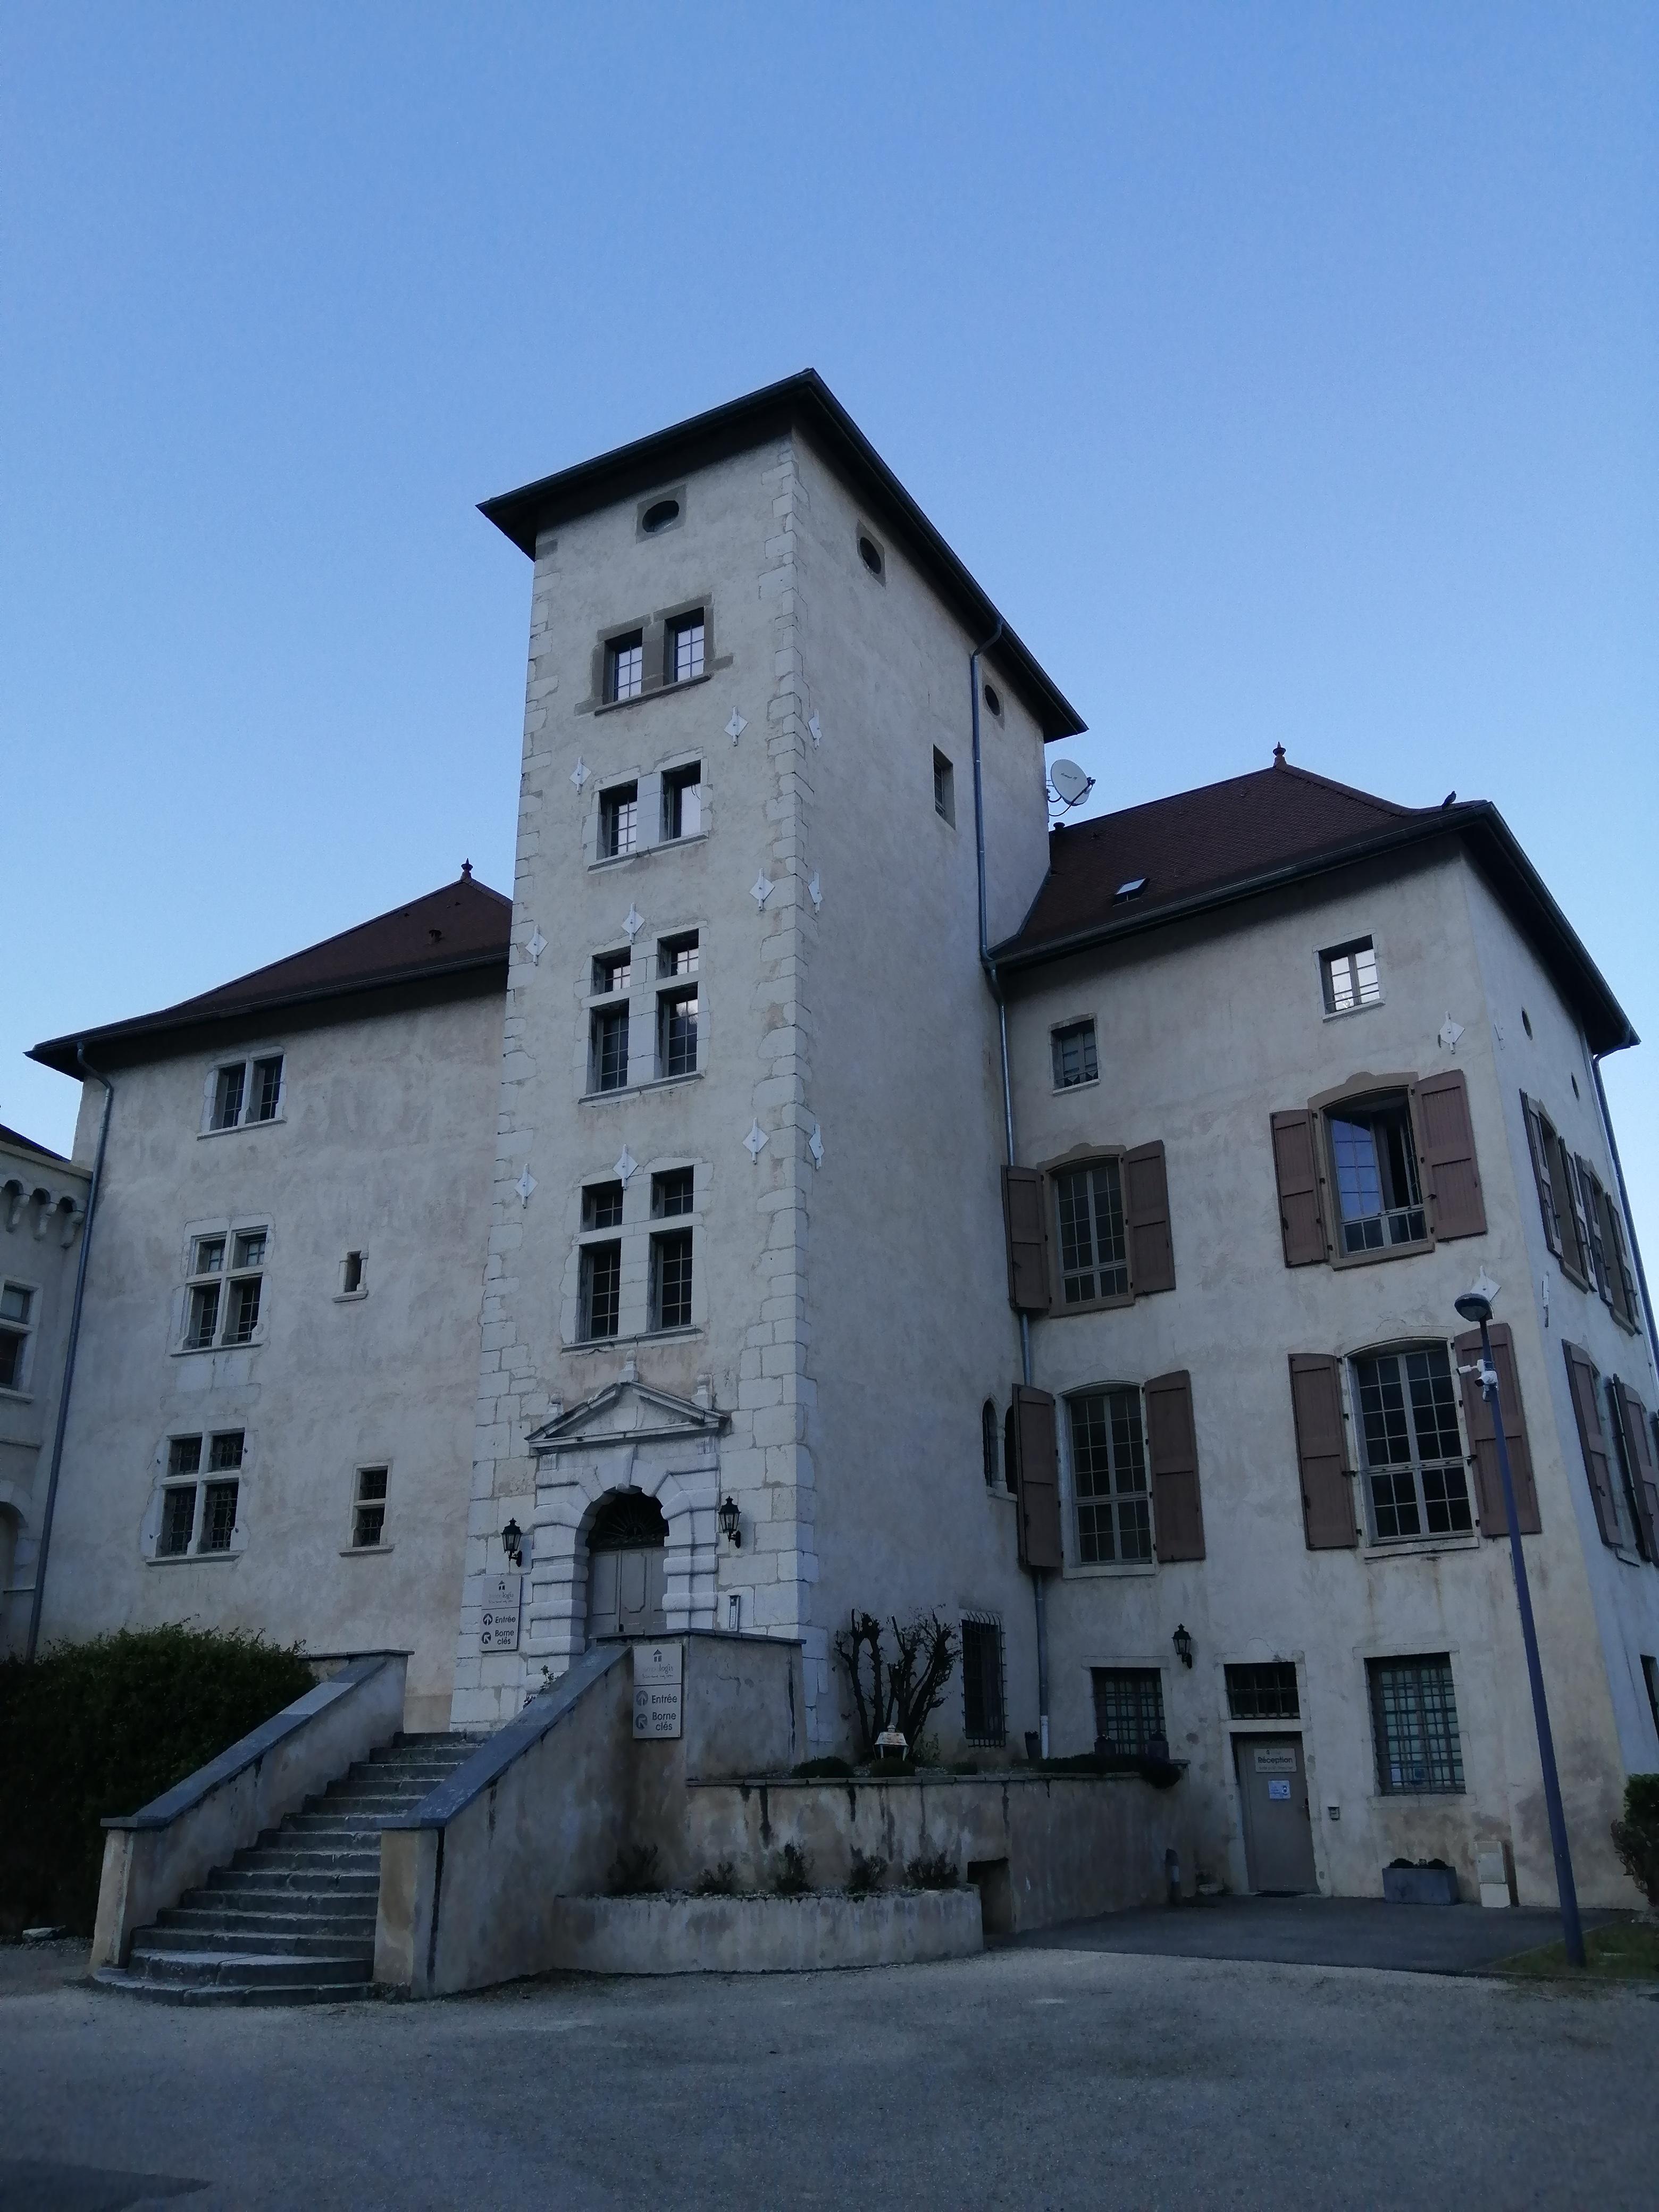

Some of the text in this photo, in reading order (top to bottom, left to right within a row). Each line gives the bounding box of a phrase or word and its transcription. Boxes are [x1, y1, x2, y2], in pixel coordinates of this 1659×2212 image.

[495, 1615, 516, 1623] Entrée
[497, 1637, 511, 1645] clés
[652, 1694, 677, 1704] Entrée
[656, 1721, 673, 1731] clés
